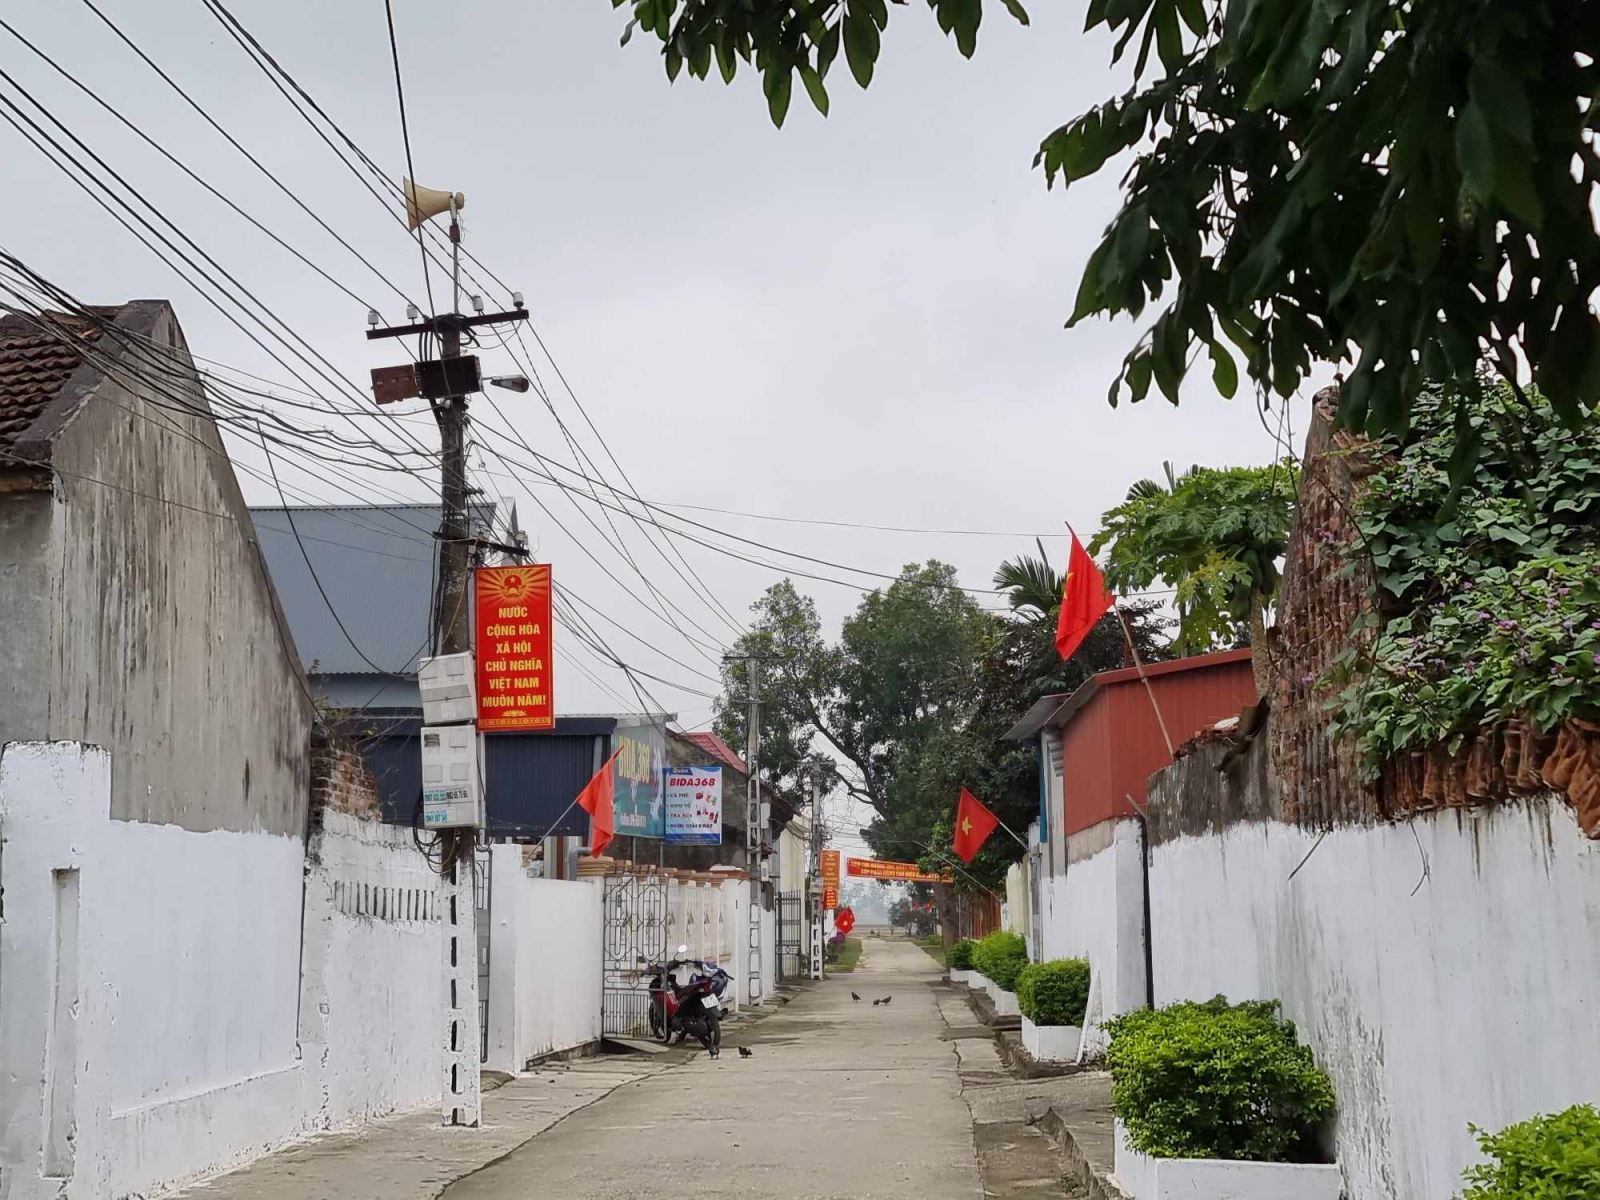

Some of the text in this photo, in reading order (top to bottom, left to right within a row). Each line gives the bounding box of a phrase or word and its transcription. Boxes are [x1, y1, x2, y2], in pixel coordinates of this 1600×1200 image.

[498, 605, 528, 619] NƯỚC
[486, 621, 541, 639] CỘNG HÒA
[496, 641, 532, 656] XÃ HỘI
[485, 656, 543, 672] CHỦ NGHĨA
[489, 676, 540, 692] VIỆT NAM
[482, 693, 547, 708] MUÔN NĂM!
[669, 777, 716, 787] BIDA368
